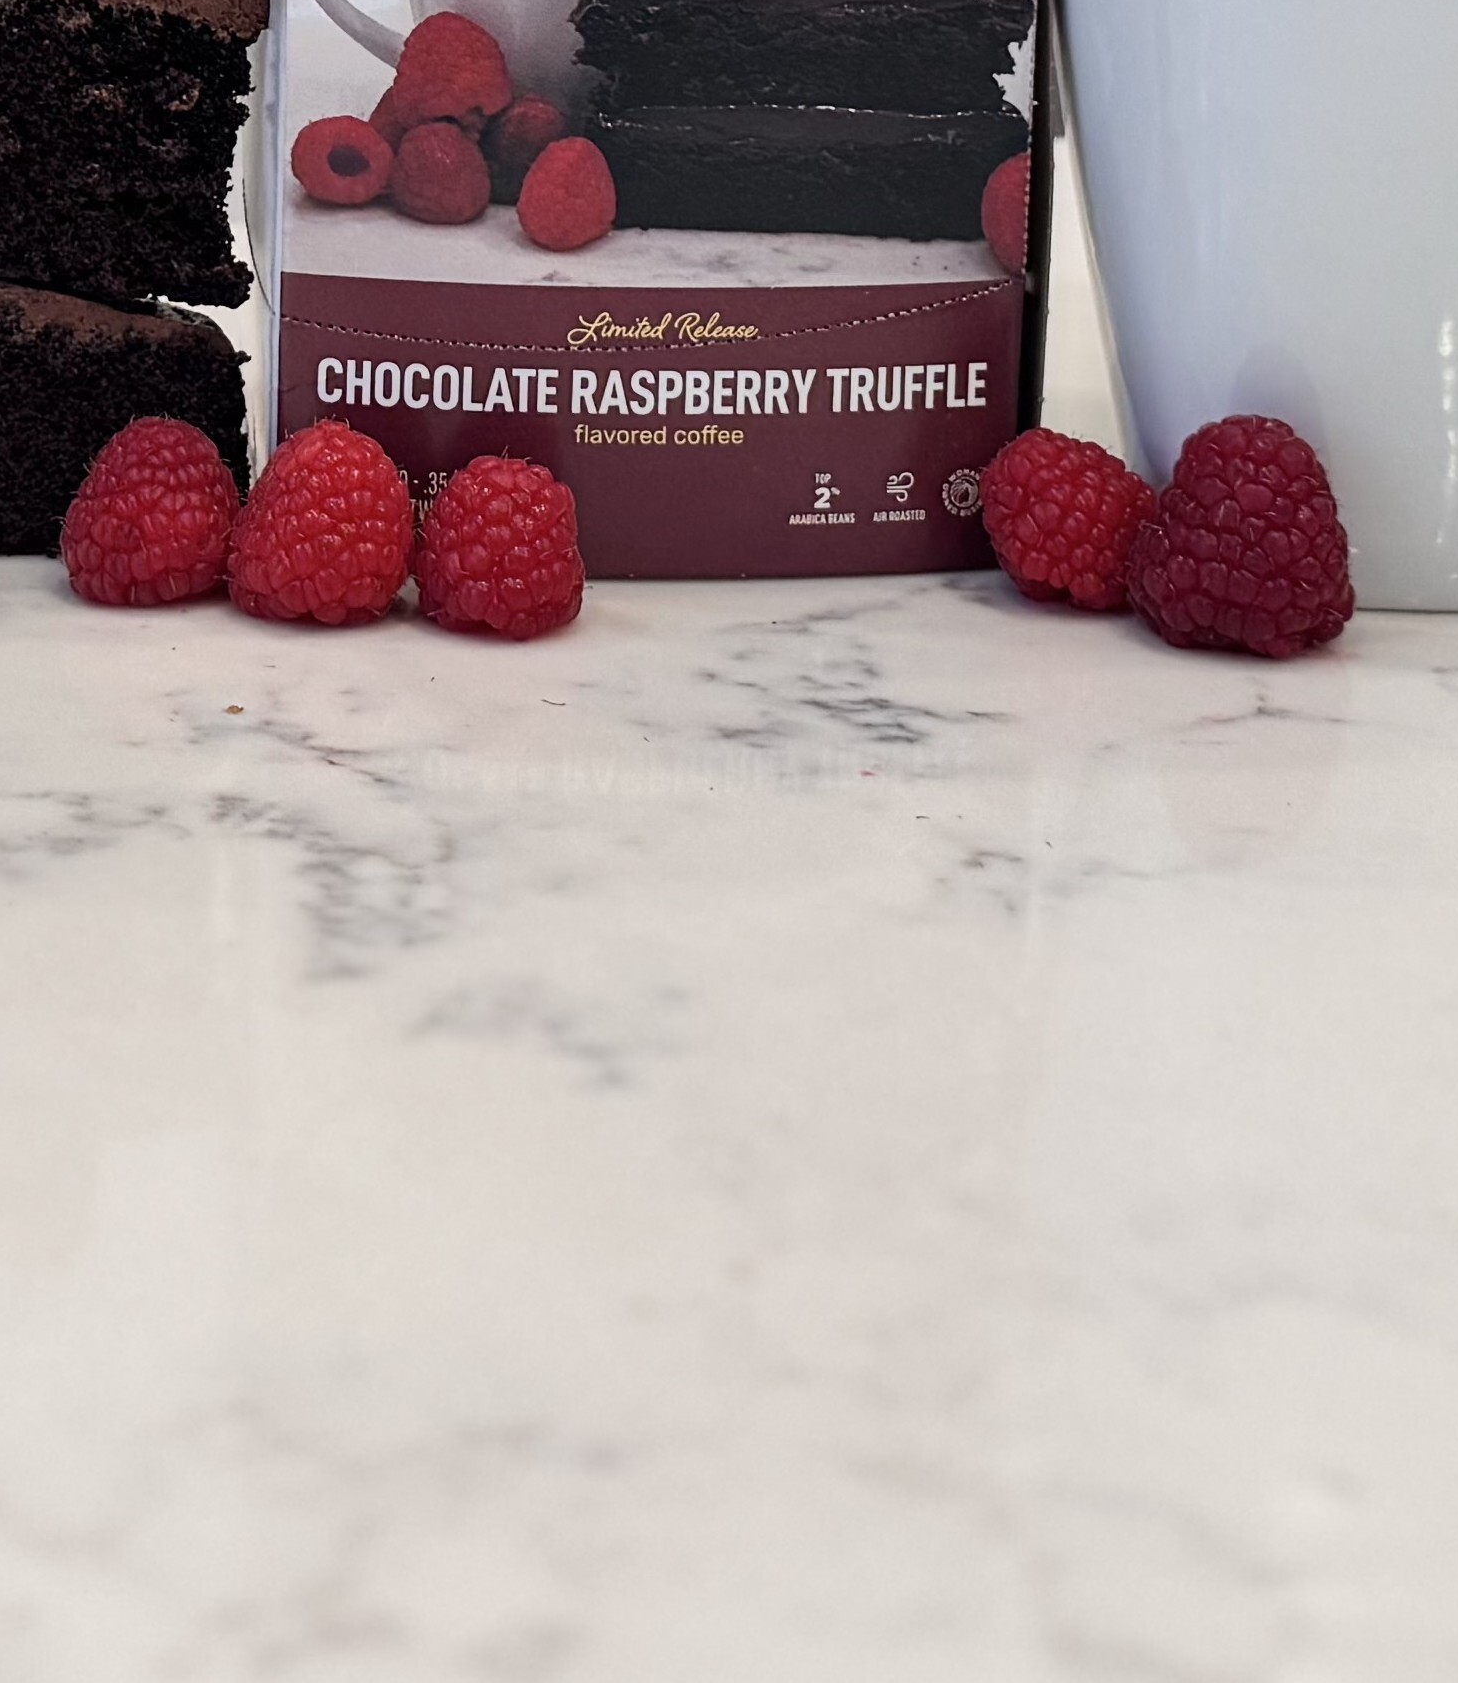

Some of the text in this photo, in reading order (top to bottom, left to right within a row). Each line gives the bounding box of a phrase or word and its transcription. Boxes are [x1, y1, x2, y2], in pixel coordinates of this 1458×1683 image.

[567, 311, 759, 345] Limited Release
[317, 357, 988, 416] CHOCOLATE RASPBERRY TRUFFLE
[574, 423, 745, 445] flavored coffee
[814, 473, 832, 484] TOP
[789, 513, 856, 525] ARABICA BEANS
[873, 509, 926, 522] AIR ROASTED
